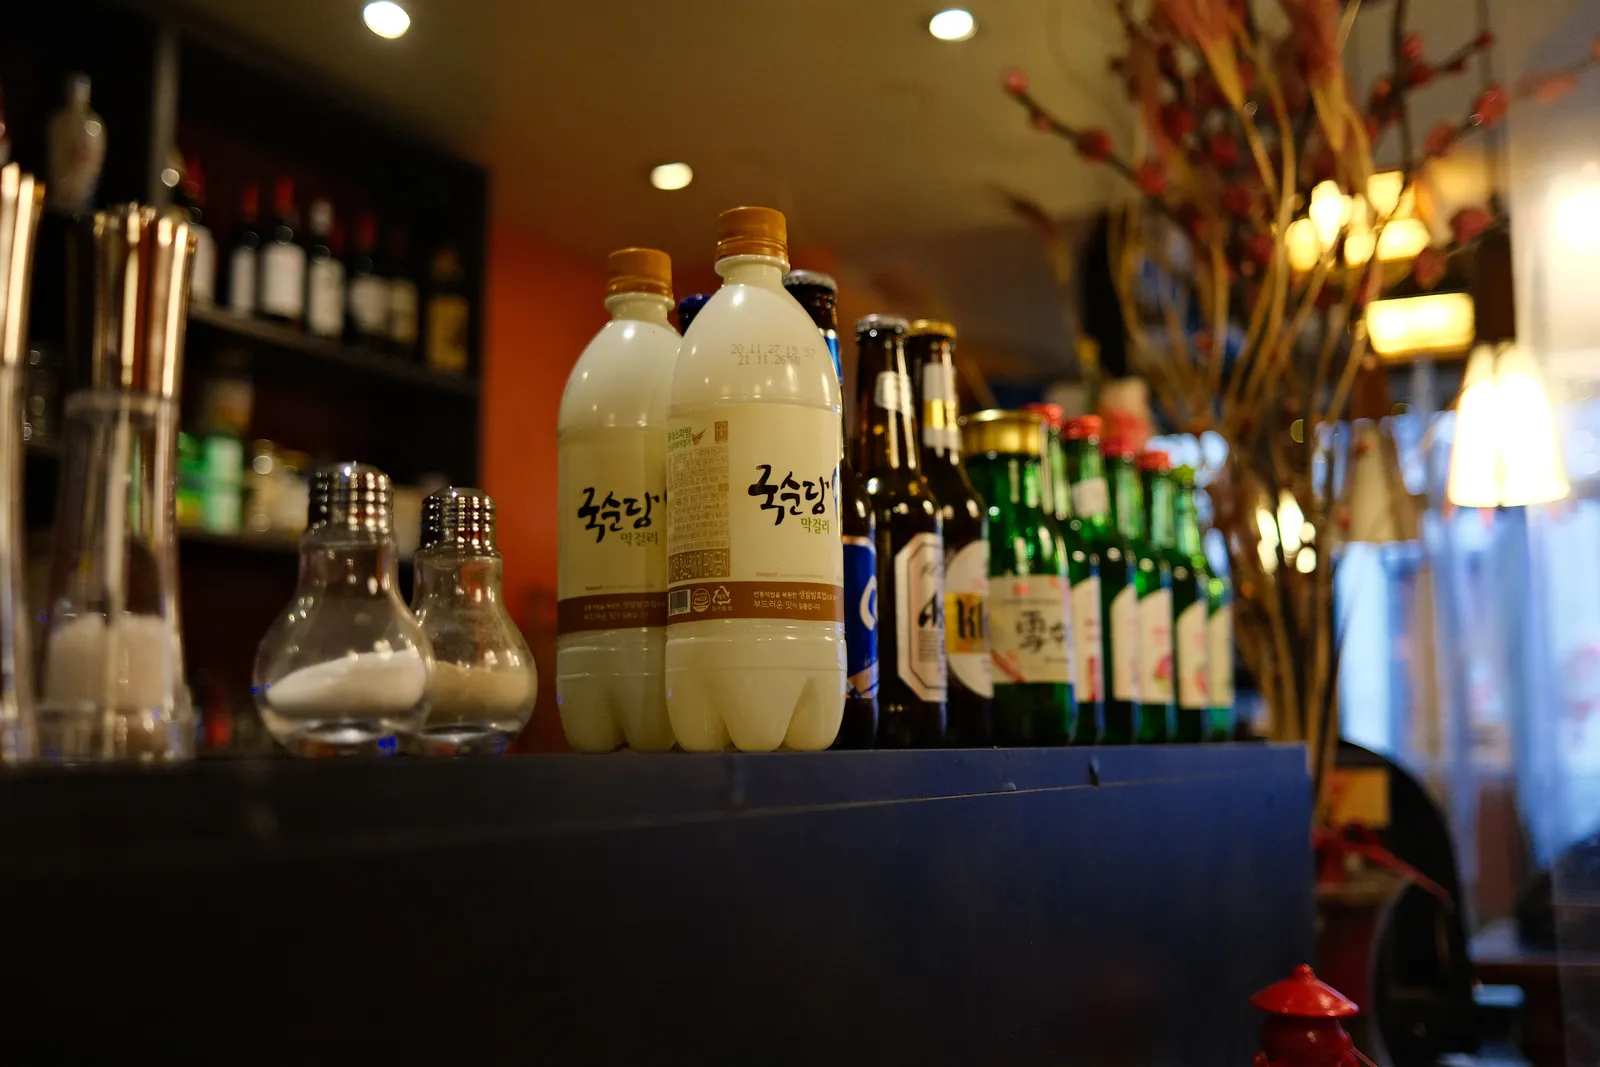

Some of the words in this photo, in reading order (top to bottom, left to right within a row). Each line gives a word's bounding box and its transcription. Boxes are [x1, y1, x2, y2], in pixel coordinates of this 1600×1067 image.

[747, 464, 830, 526] 국순당
[577, 487, 660, 543] 국순당
[800, 517, 830, 534] 막걸리
[620, 531, 658, 546] 막걸리
[753, 600, 784, 610] 부드러운
